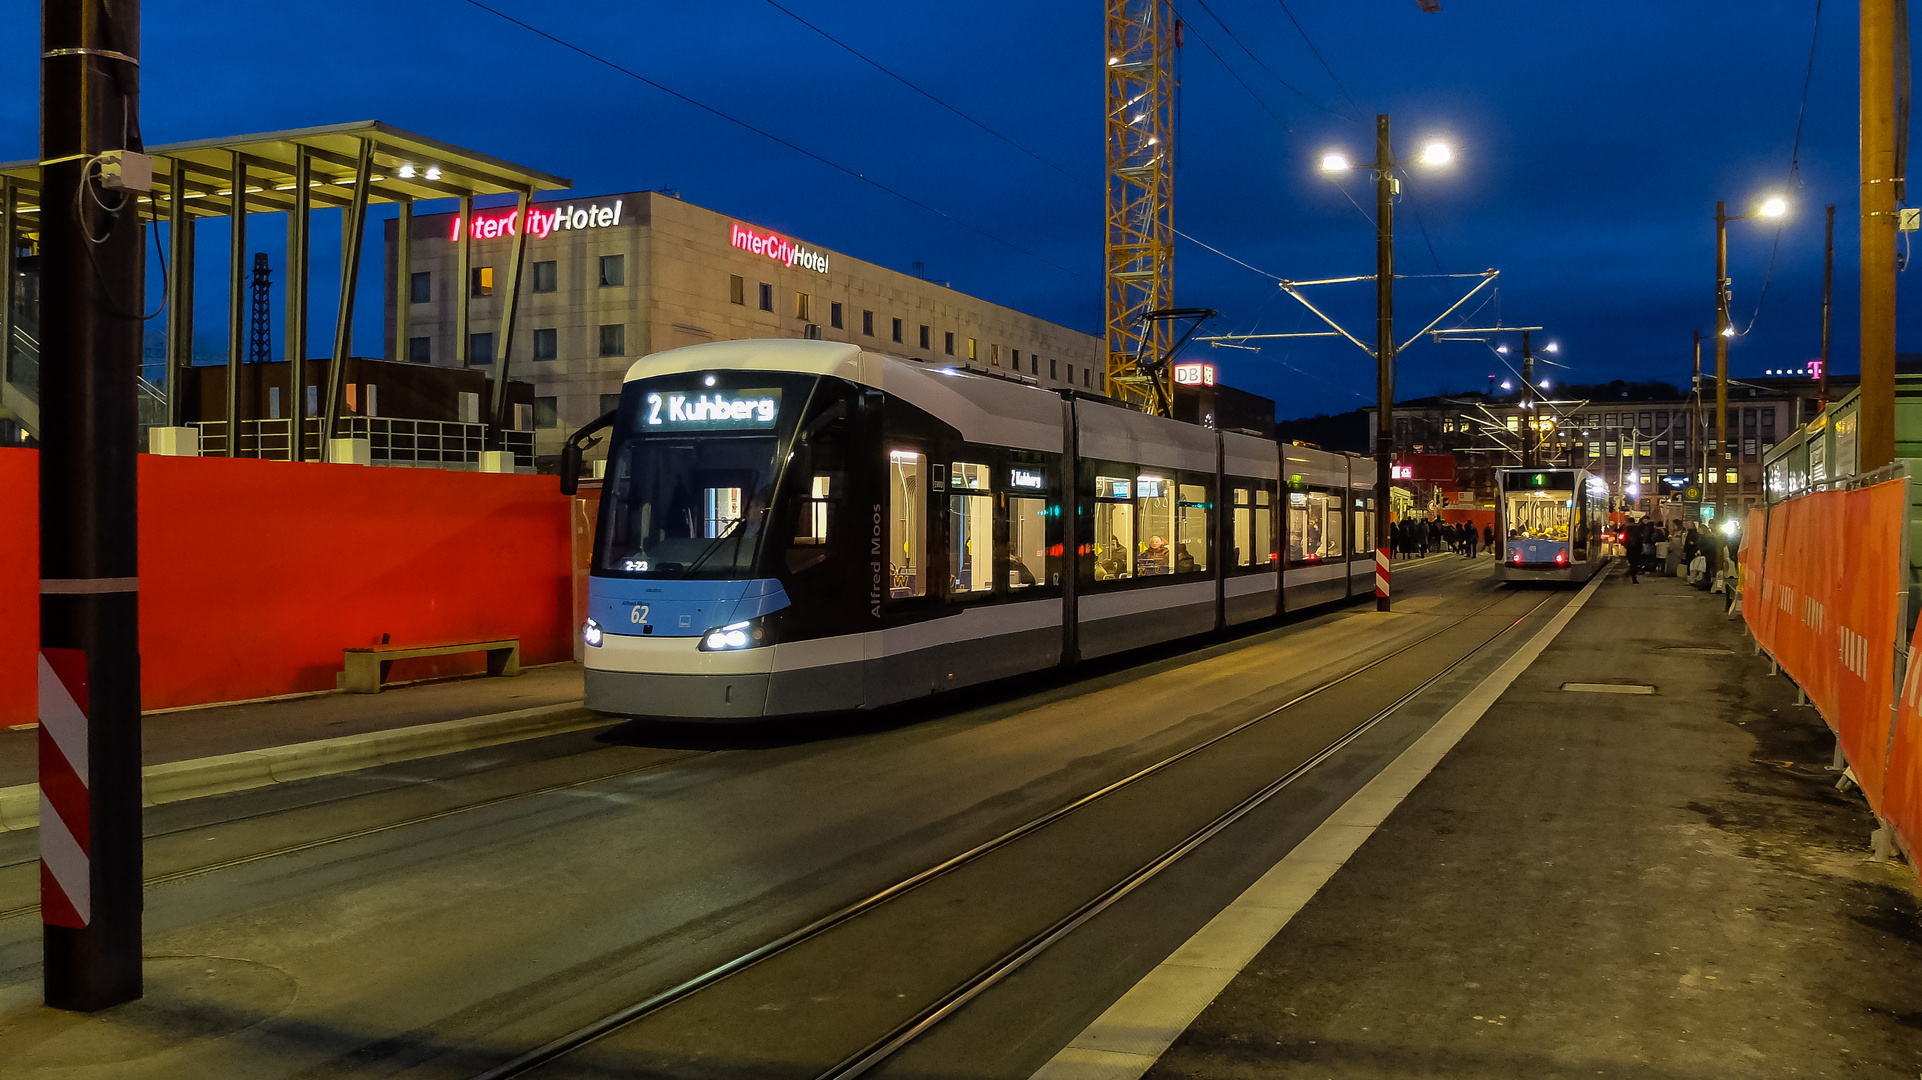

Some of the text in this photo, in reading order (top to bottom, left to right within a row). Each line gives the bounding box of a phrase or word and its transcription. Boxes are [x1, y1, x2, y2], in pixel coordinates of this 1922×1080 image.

[451, 200, 623, 241] IterCityHotel
[730, 223, 830, 274] InterCityHotel
[1178, 368, 1198, 382] DB
[647, 394, 776, 425] 2 Kuhberg
[870, 503, 882, 619] Alfred Moos
[631, 605, 649, 624] 62
